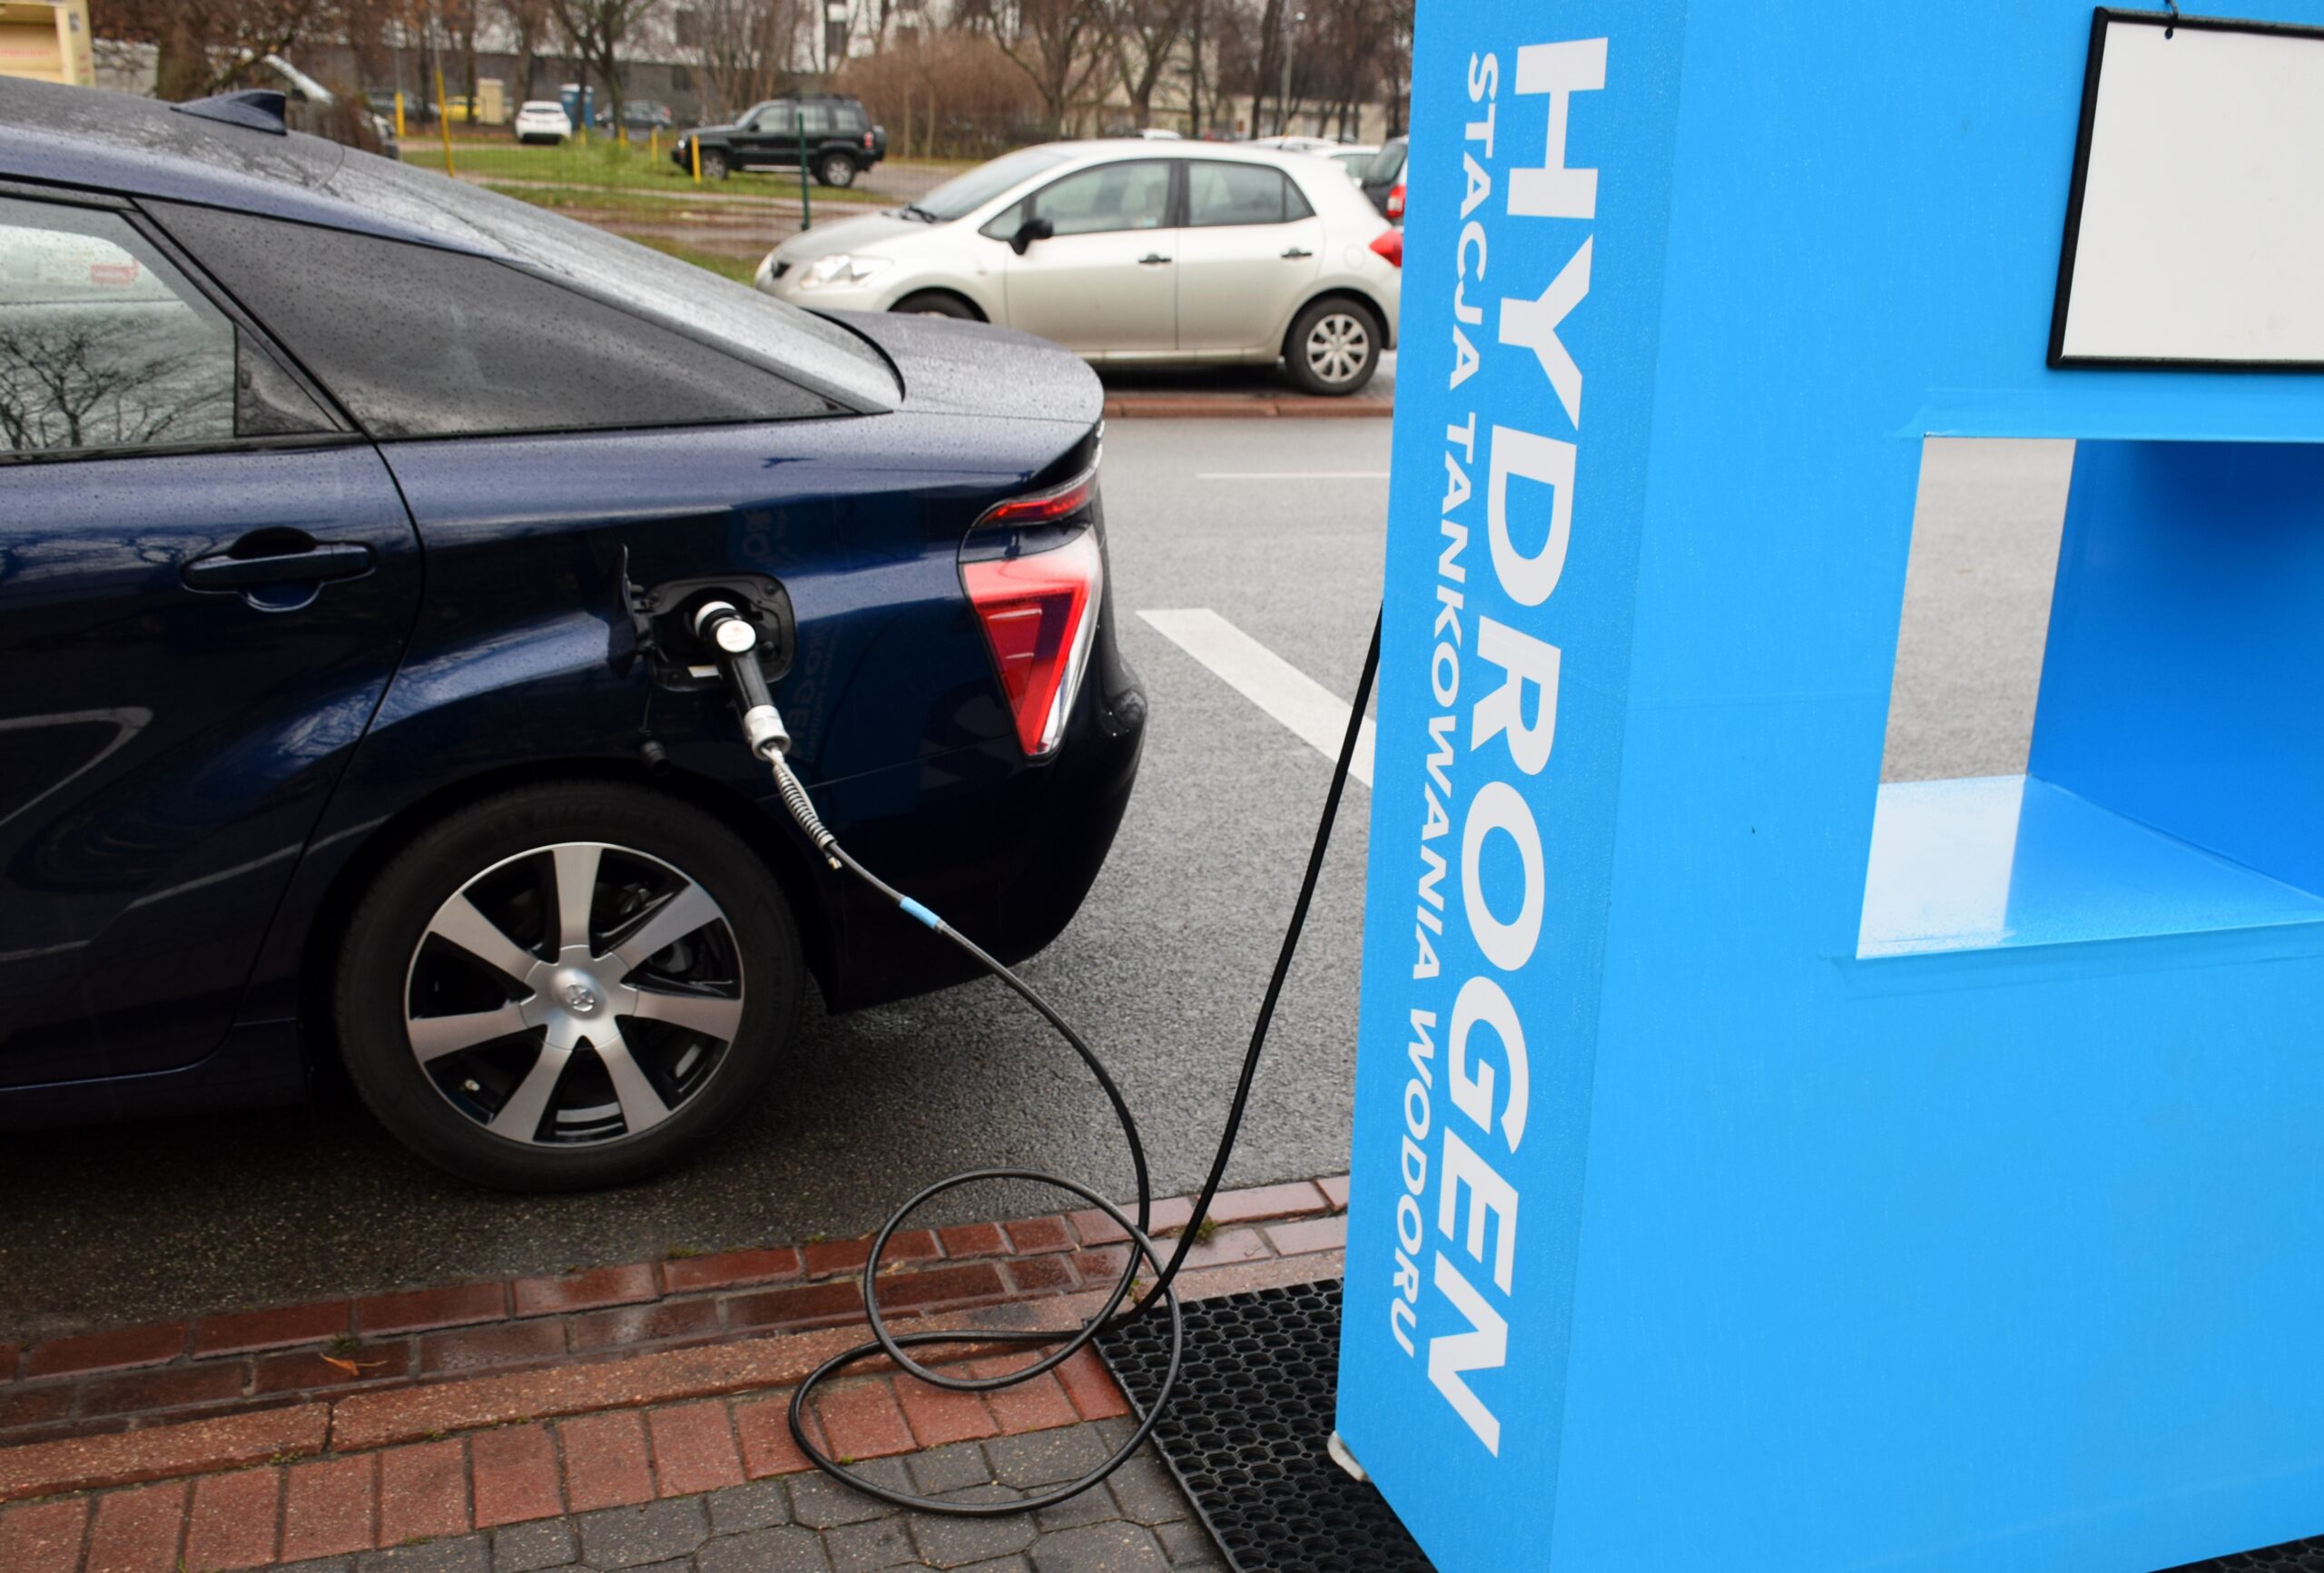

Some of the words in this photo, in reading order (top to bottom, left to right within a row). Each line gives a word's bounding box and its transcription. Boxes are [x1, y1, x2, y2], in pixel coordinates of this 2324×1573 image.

[1450, 52, 1499, 390] STACJA
[1413, 411, 1476, 979] TANKOWANIA
[1428, 37, 1609, 1458] HYDROGEN
[1390, 1008, 1436, 1358] WODORU
